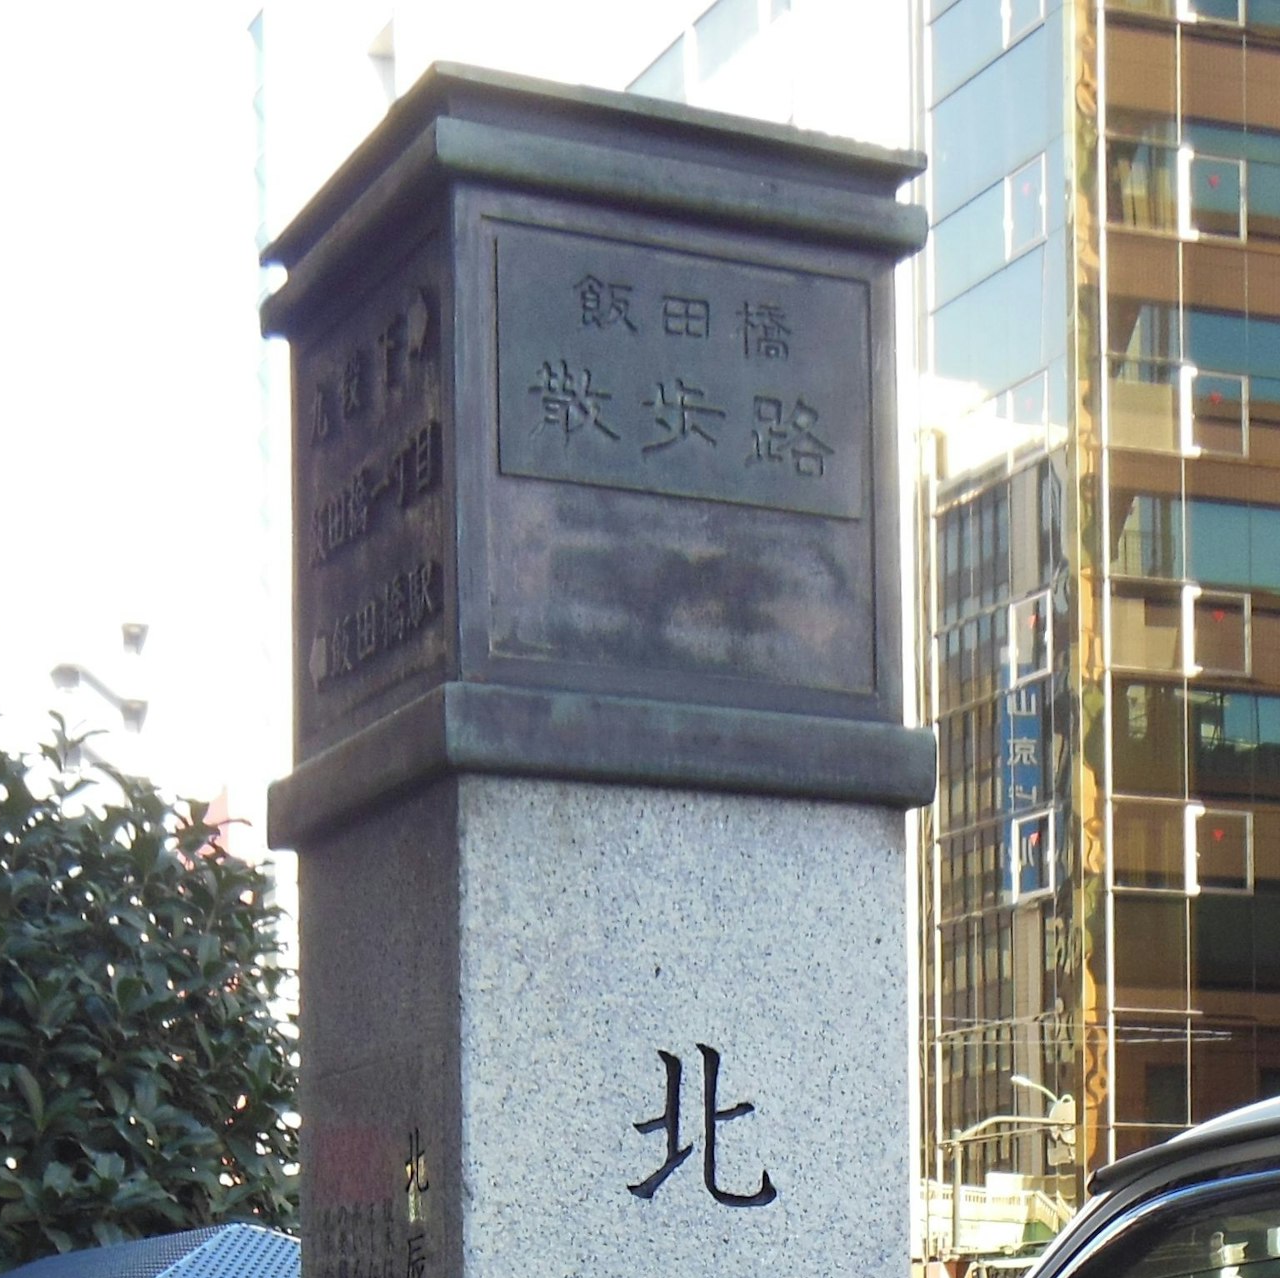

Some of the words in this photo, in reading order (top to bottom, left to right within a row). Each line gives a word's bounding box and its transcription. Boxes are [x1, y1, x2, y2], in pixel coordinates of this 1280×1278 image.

[574, 274, 791, 359] 飯田橋
[528, 359, 834, 476] 散歩路
